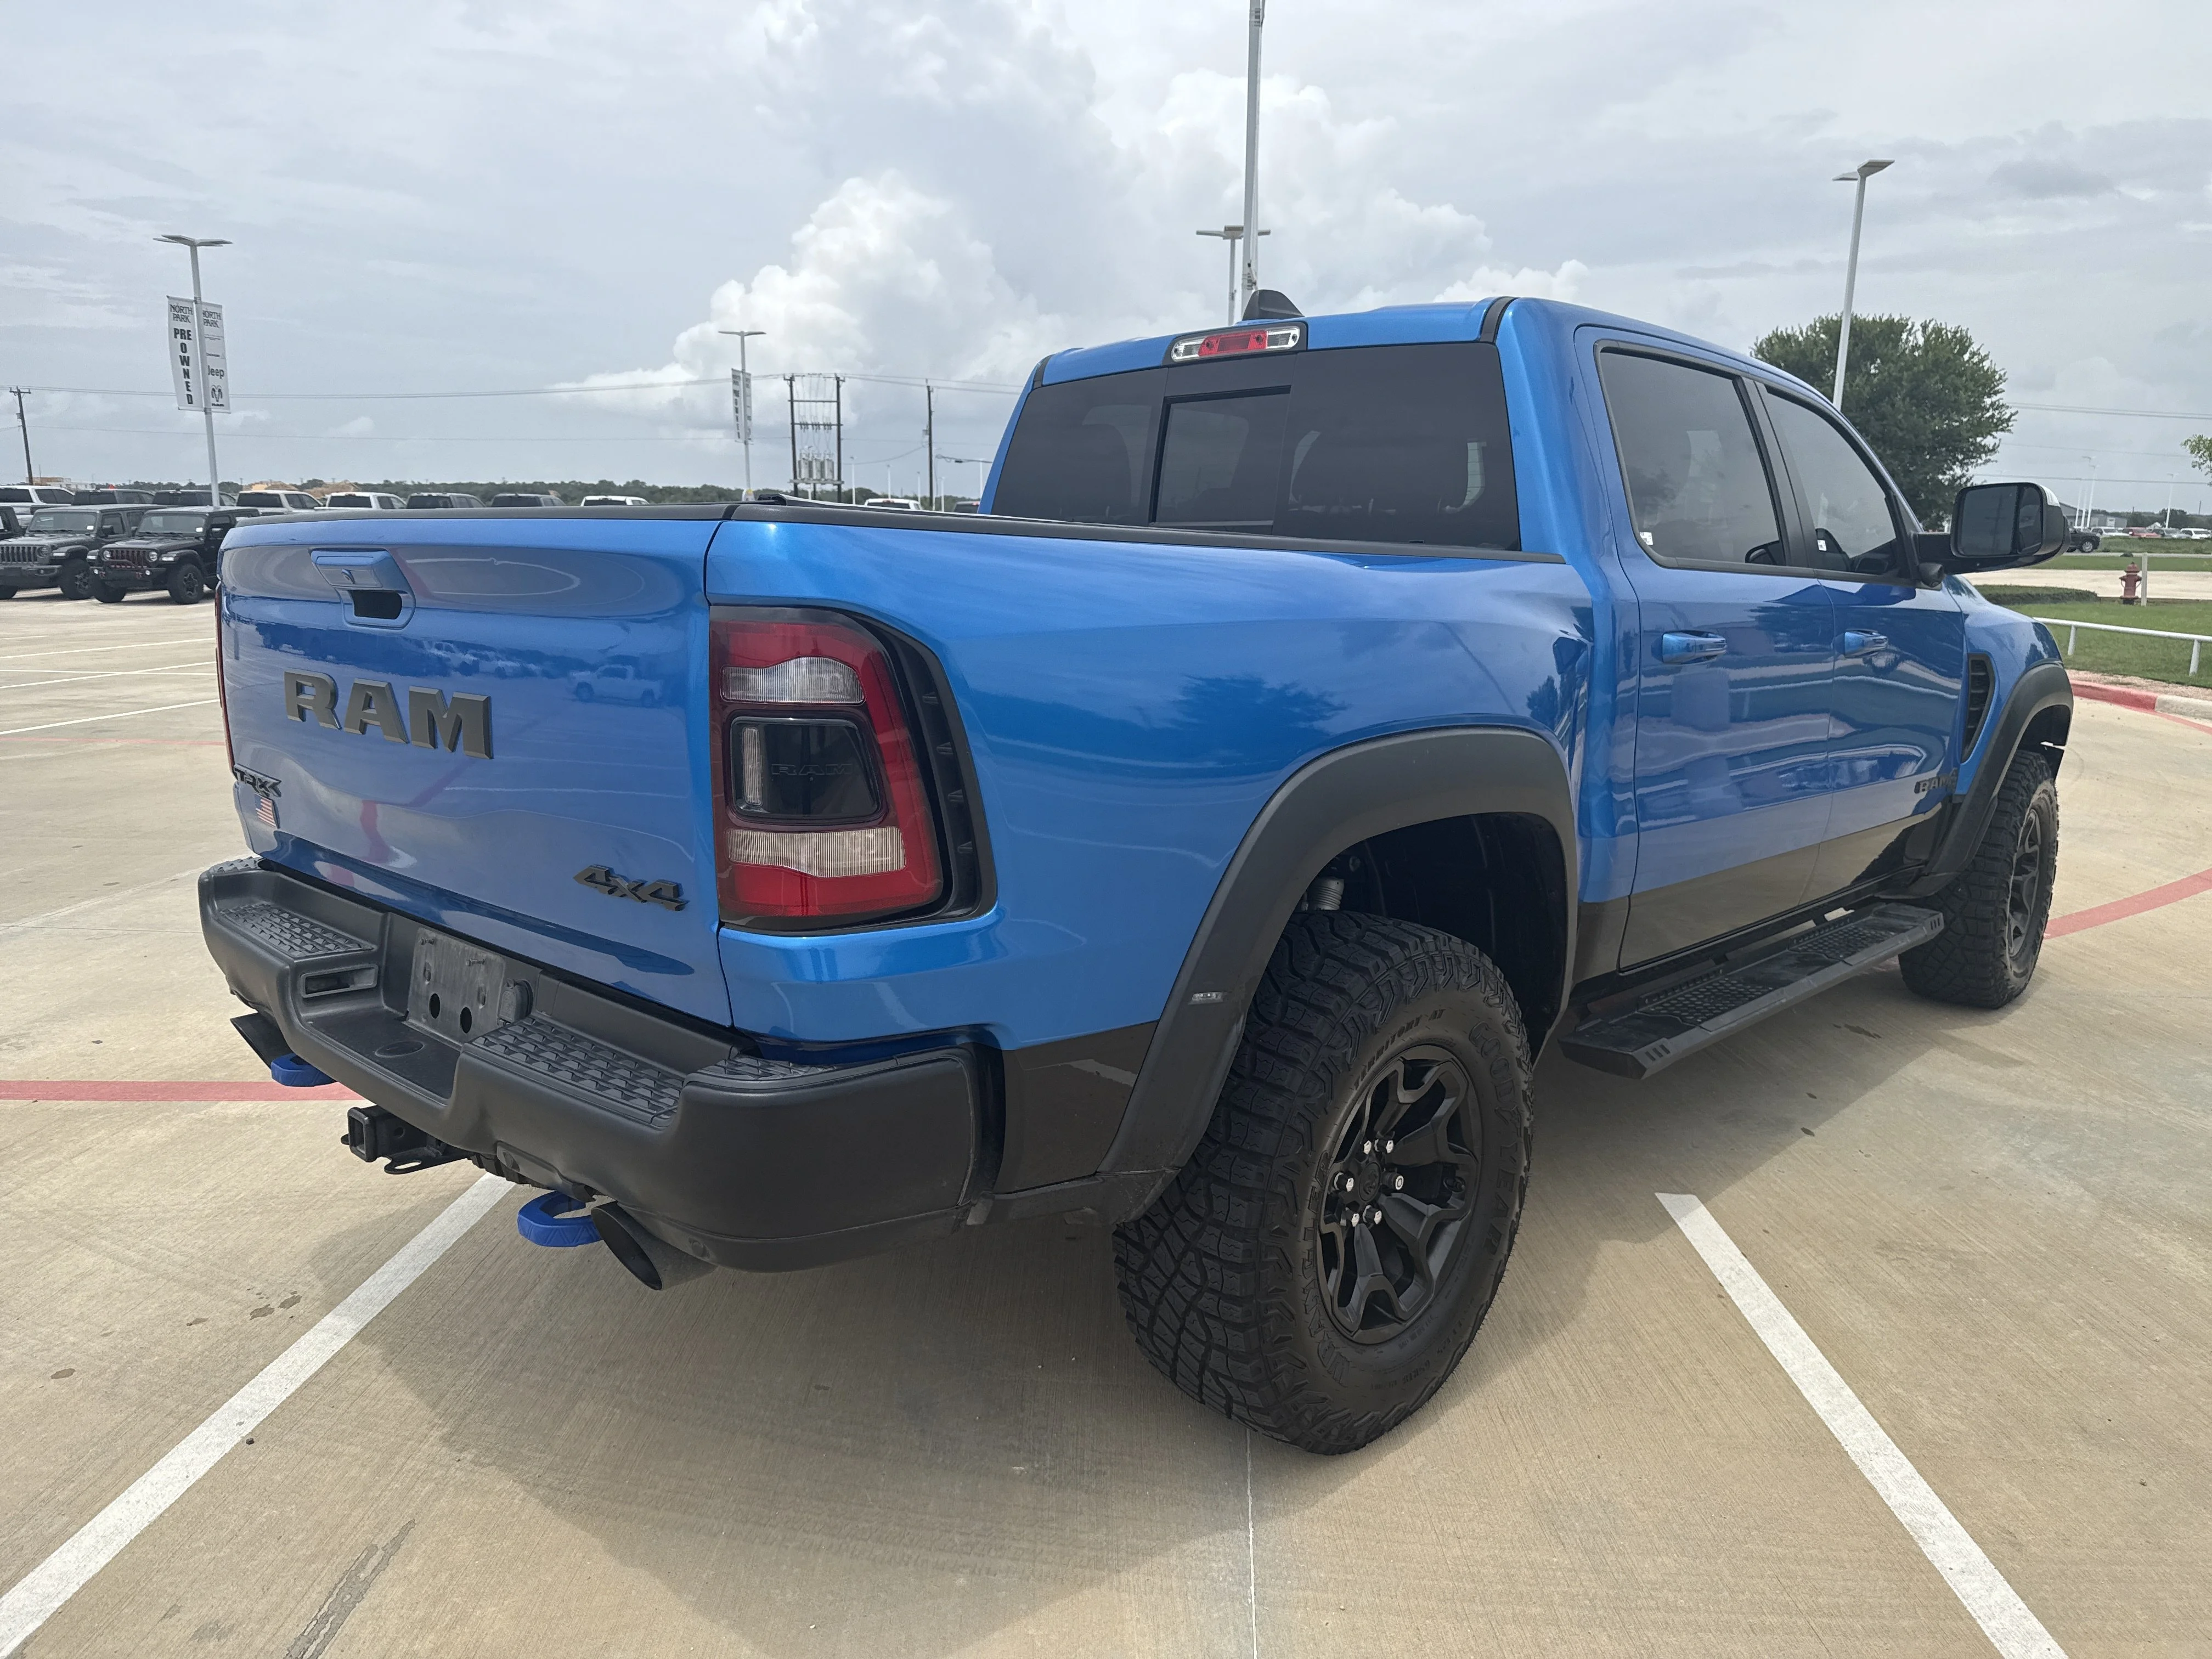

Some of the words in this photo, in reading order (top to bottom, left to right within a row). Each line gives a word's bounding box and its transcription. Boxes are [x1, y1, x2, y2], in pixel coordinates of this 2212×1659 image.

[170, 304, 193, 315] NORTH
[172, 313, 191, 324] PARK
[203, 318, 220, 329] PARK
[174, 328, 192, 341] PRE
[207, 365, 225, 379] Jeep
[284, 667, 494, 760] RAM
[771, 763, 853, 776] RAM
[233, 763, 281, 798] TRX
[1353, 1015, 1422, 1092] TERRITORY
[1468, 1021, 1521, 1256] GOODYEAR
[1302, 1150, 1350, 1388] WRANGLER
